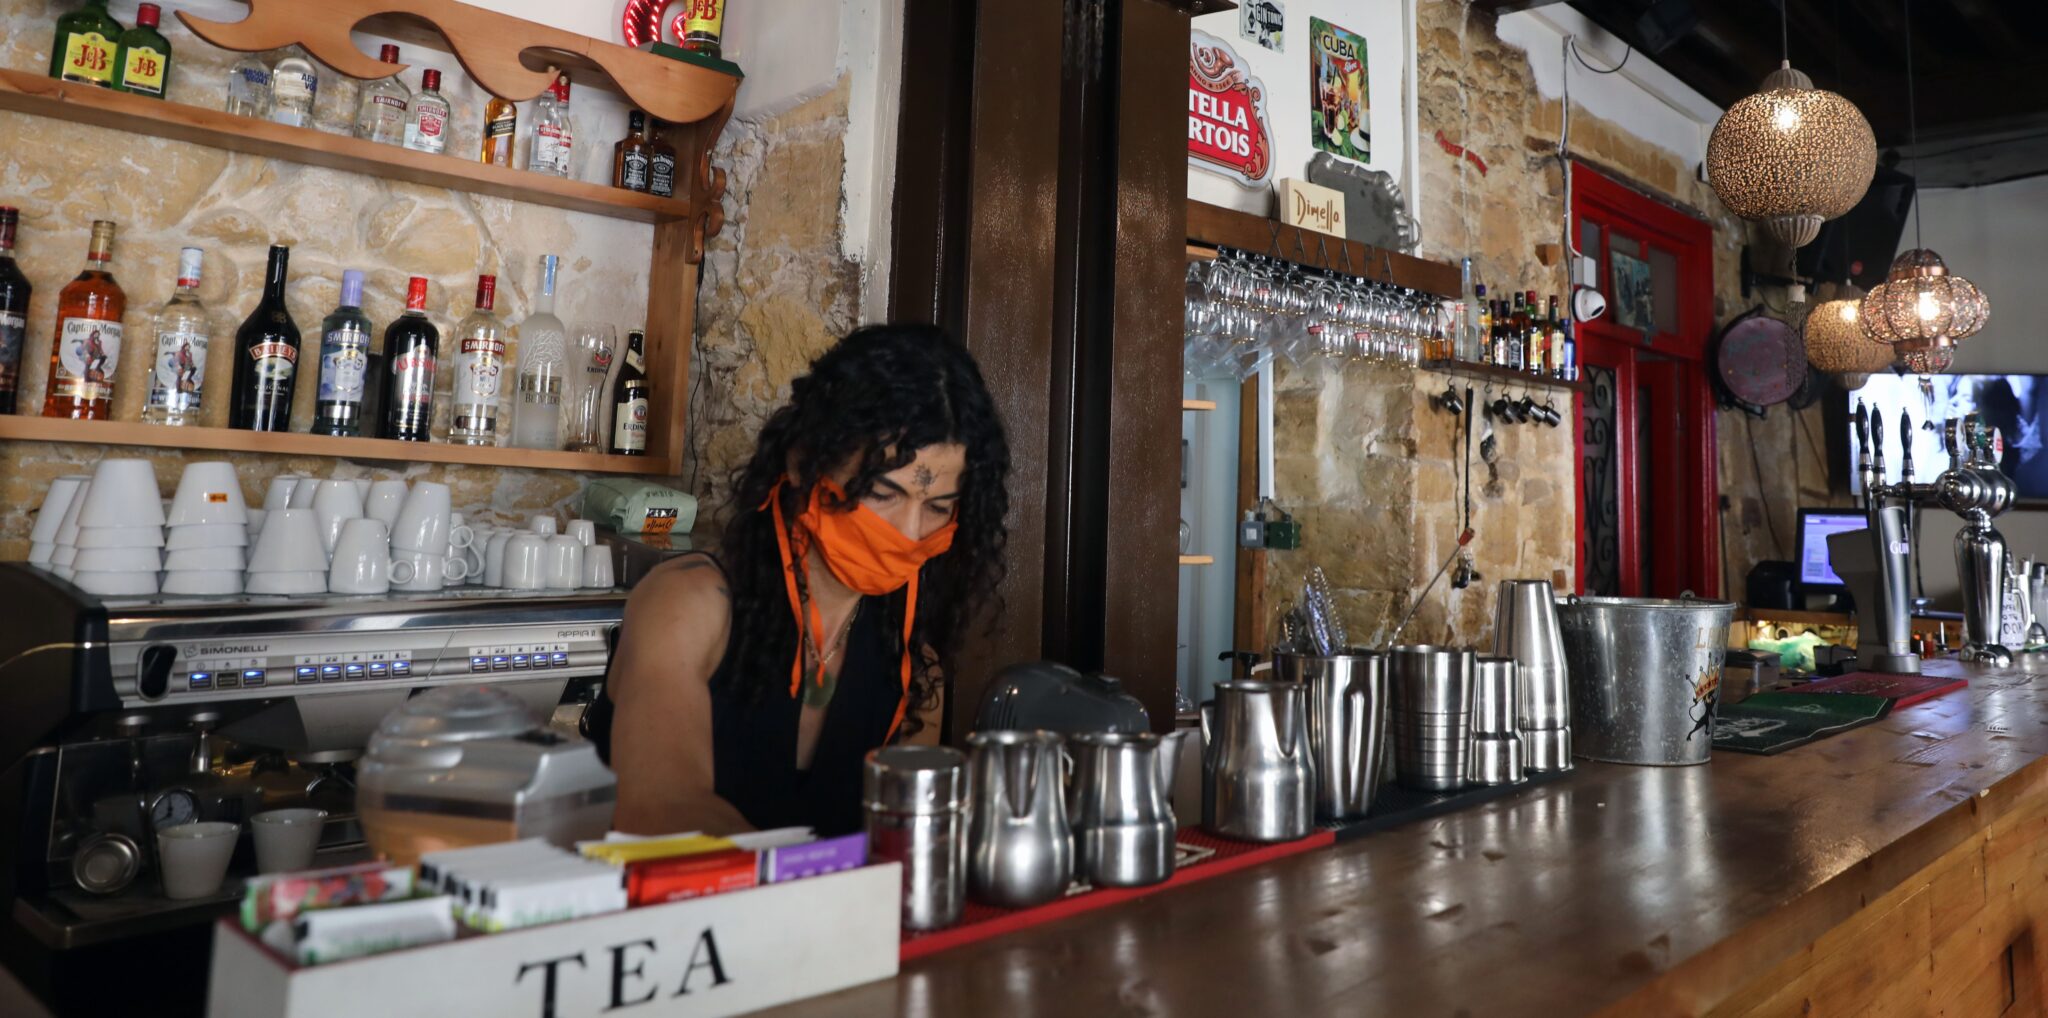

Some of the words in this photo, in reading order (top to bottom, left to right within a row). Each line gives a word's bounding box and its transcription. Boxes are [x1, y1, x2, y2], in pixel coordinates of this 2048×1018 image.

[74, 44, 107, 71] J&B
[1323, 34, 1355, 61] CUBA
[132, 56, 157, 77] J&B
[1188, 115, 1250, 157] RTOIS
[1293, 188, 1340, 233] Dimello
[254, 343, 296, 360] BAILEYS
[200, 645, 268, 655] SIMONELLI
[514, 926, 735, 1018] TEA
